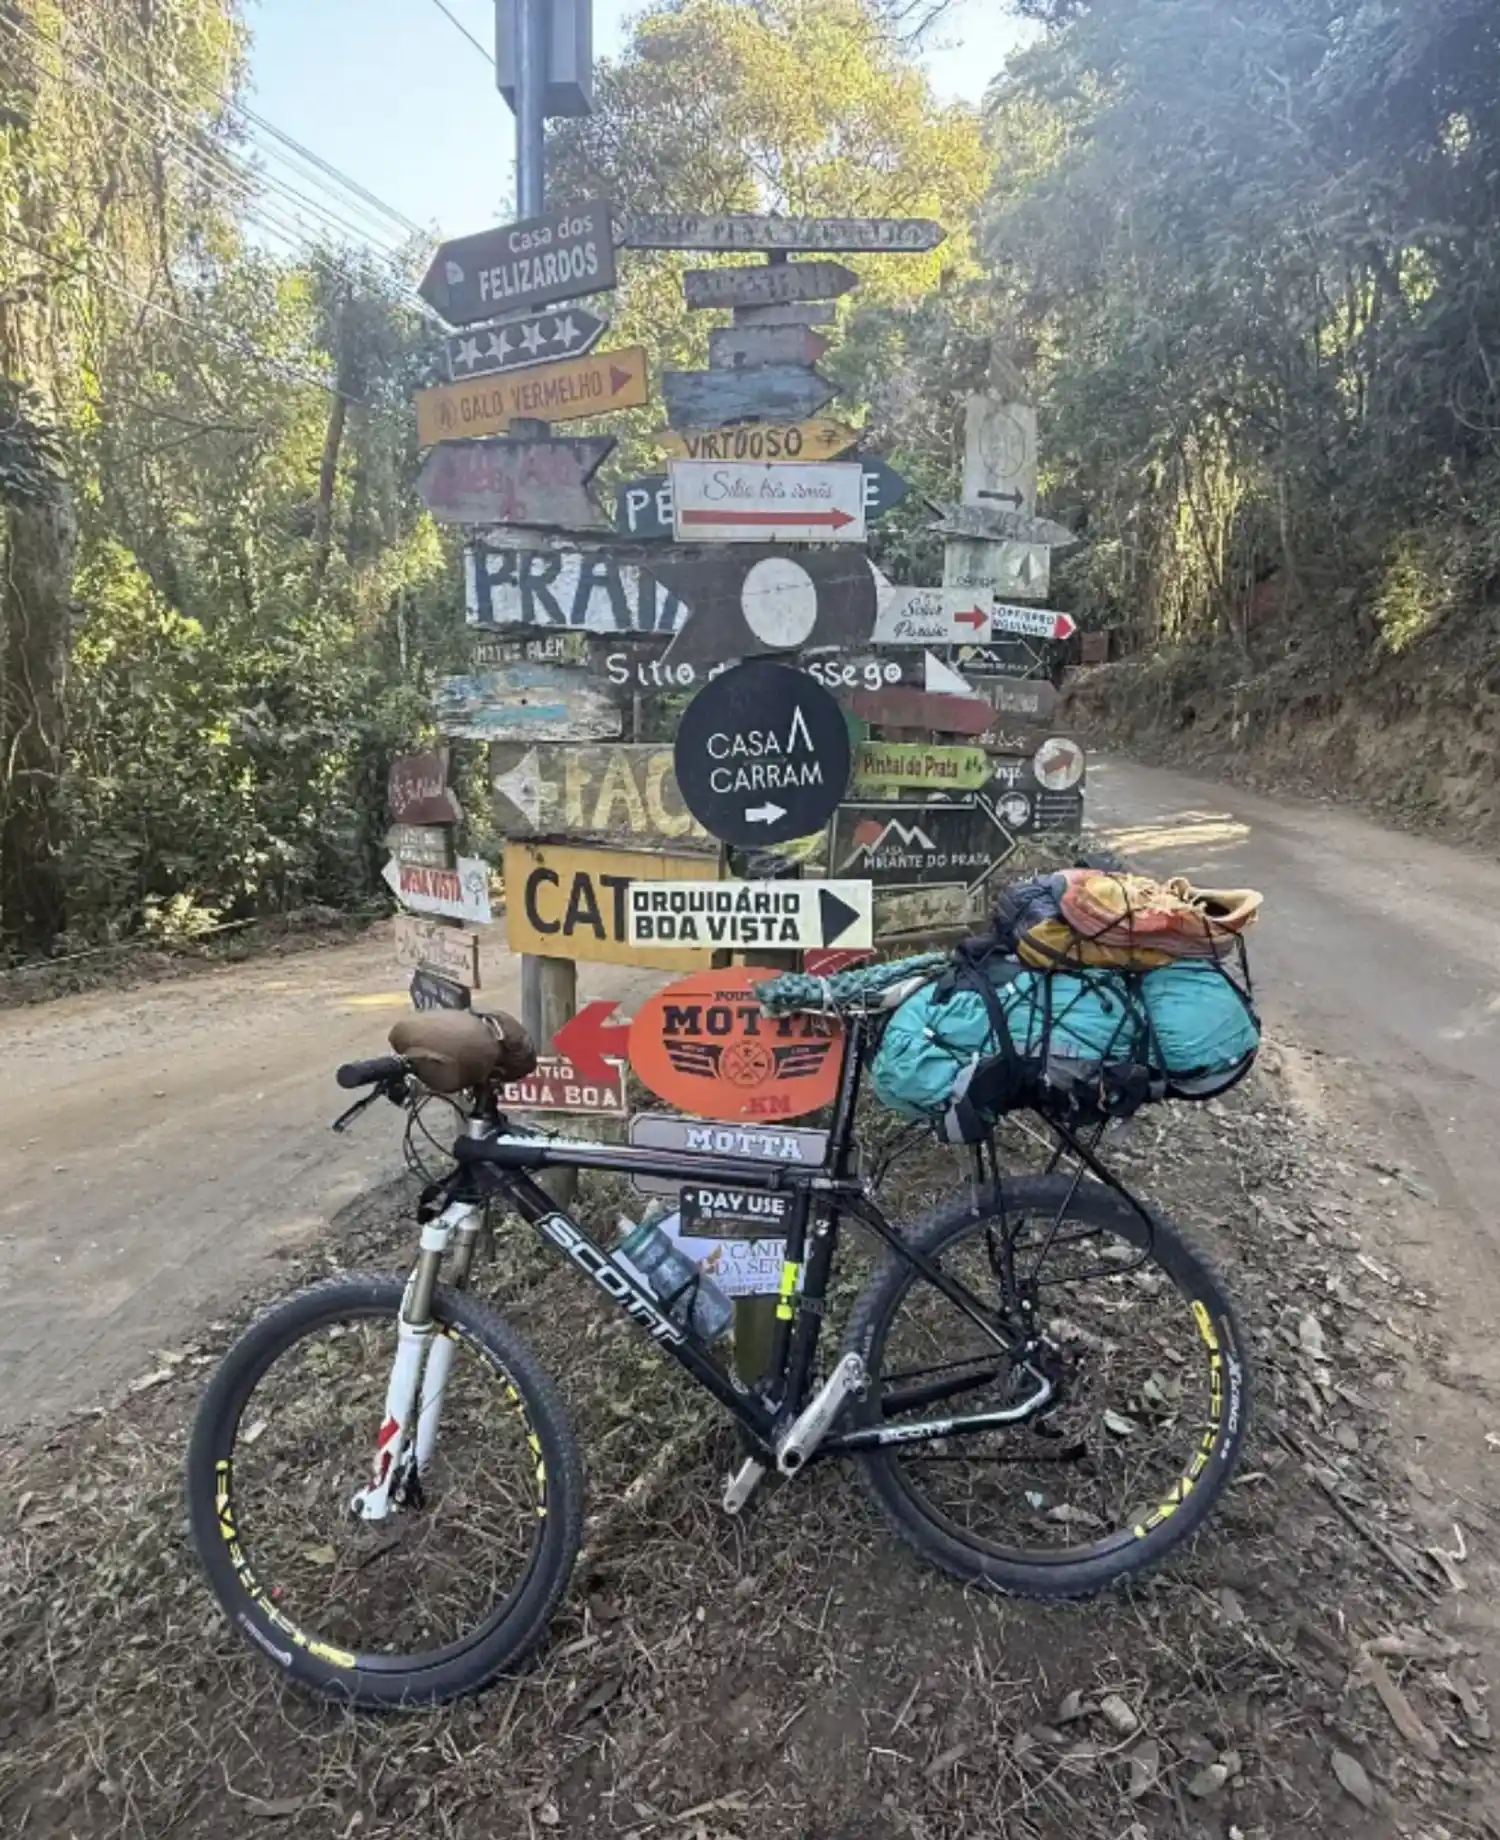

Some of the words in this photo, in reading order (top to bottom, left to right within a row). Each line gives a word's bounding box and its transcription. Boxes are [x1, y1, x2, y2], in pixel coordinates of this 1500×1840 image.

[508, 227, 551, 253] Casa
[557, 213, 594, 239] dos
[477, 241, 599, 302] FELIZARDOS
[460, 391, 504, 423] GALO
[510, 370, 603, 413] VERMELHO
[800, 660, 902, 692] ssego
[706, 730, 781, 759] CASA
[709, 761, 824, 793] CARRAM
[864, 754, 903, 775] Pinhal
[924, 755, 958, 778] Prata
[927, 854, 949, 868] DO
[632, 886, 800, 914] ORQUIDÁRIO
[634, 914, 699, 942] BOA
[706, 915, 800, 944] VISTA
[527, 1065, 574, 1081] ITIO
[498, 1083, 555, 1105] GUA
[564, 1084, 618, 1107] BOA
[685, 1128, 803, 1160] MOTTA
[698, 1189, 744, 1211] DAY
[747, 1195, 786, 1216] USE
[730, 1241, 785, 1260] CANT
[541, 1215, 687, 1346] SCOTT
